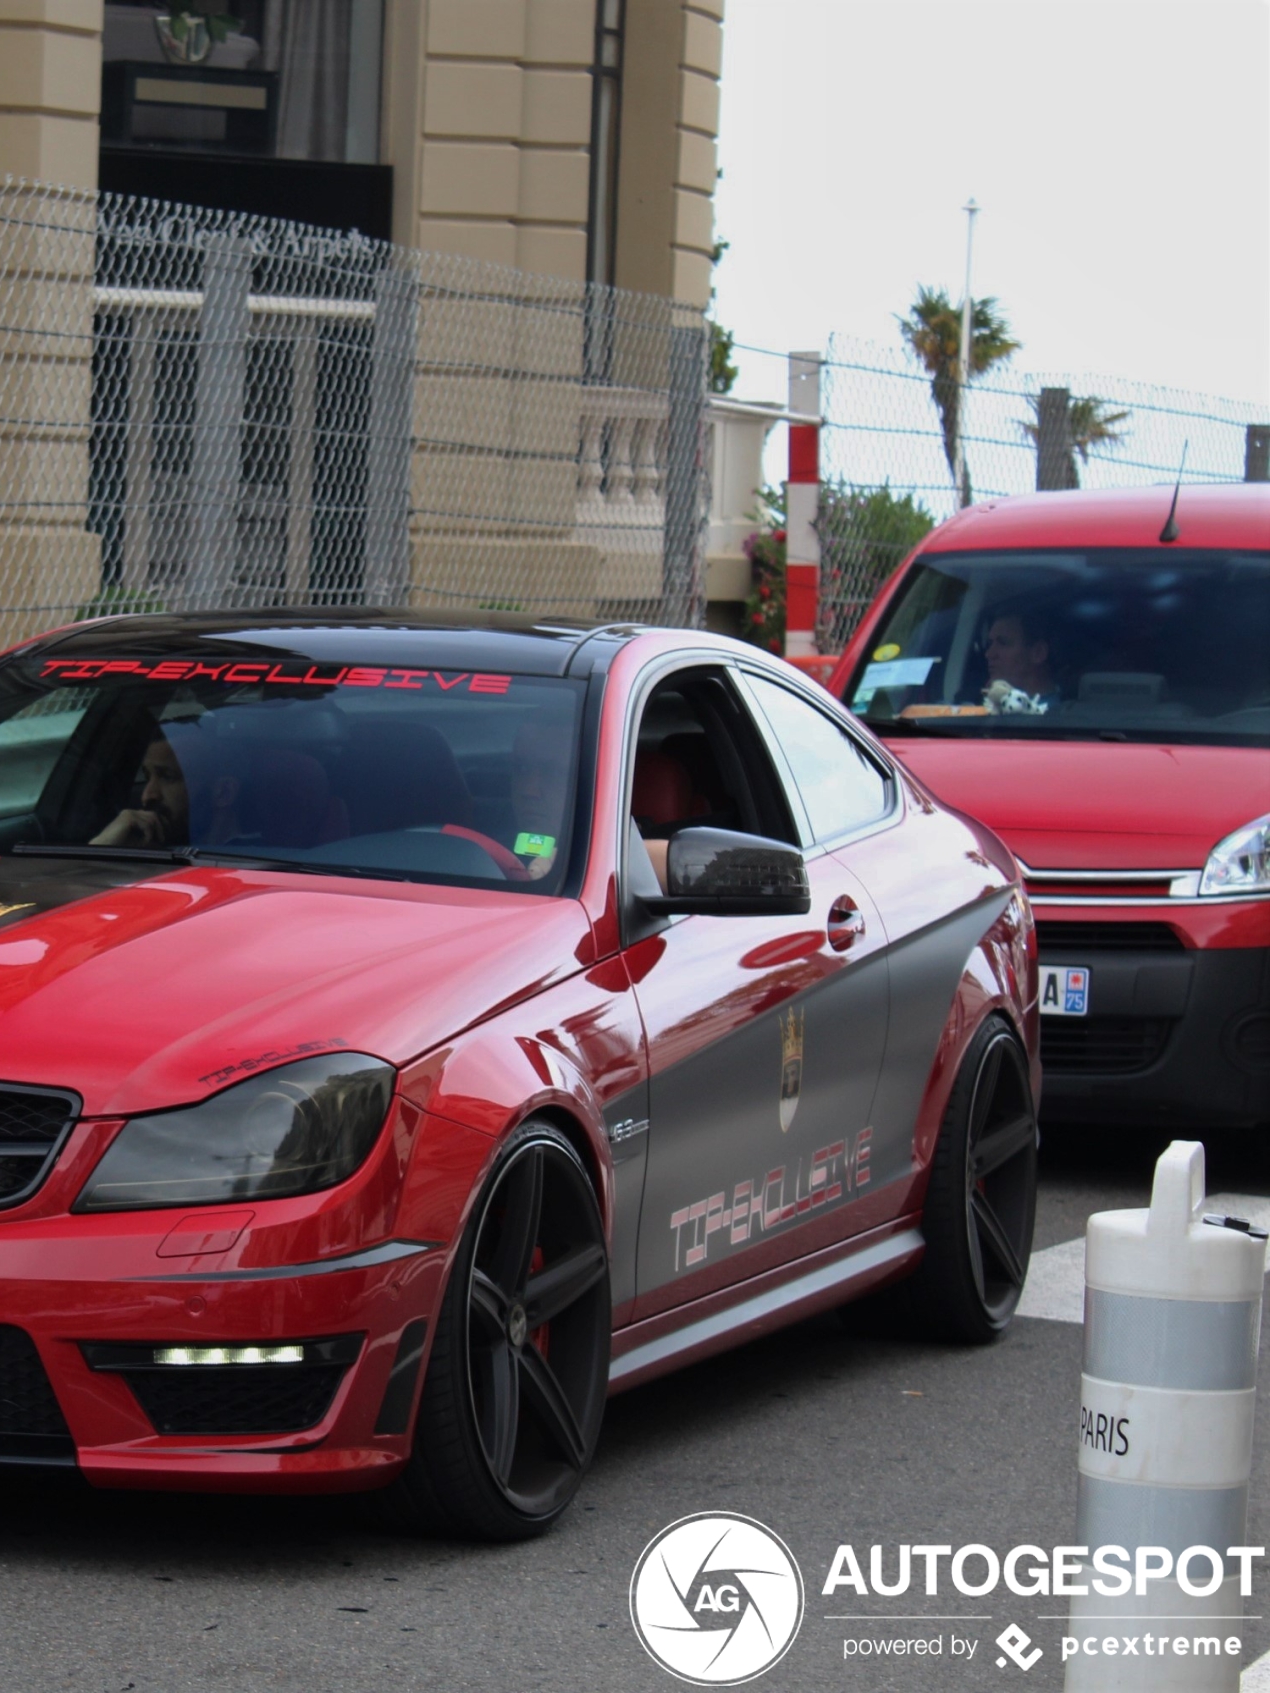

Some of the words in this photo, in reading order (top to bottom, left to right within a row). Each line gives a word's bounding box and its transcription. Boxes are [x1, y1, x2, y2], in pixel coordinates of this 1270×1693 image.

[39, 660, 512, 694] TIP-EXCLUSIVE
[1042, 973, 1059, 1007] A
[1066, 993, 1084, 1010] 75
[1080, 1405, 1130, 1457] PARIS
